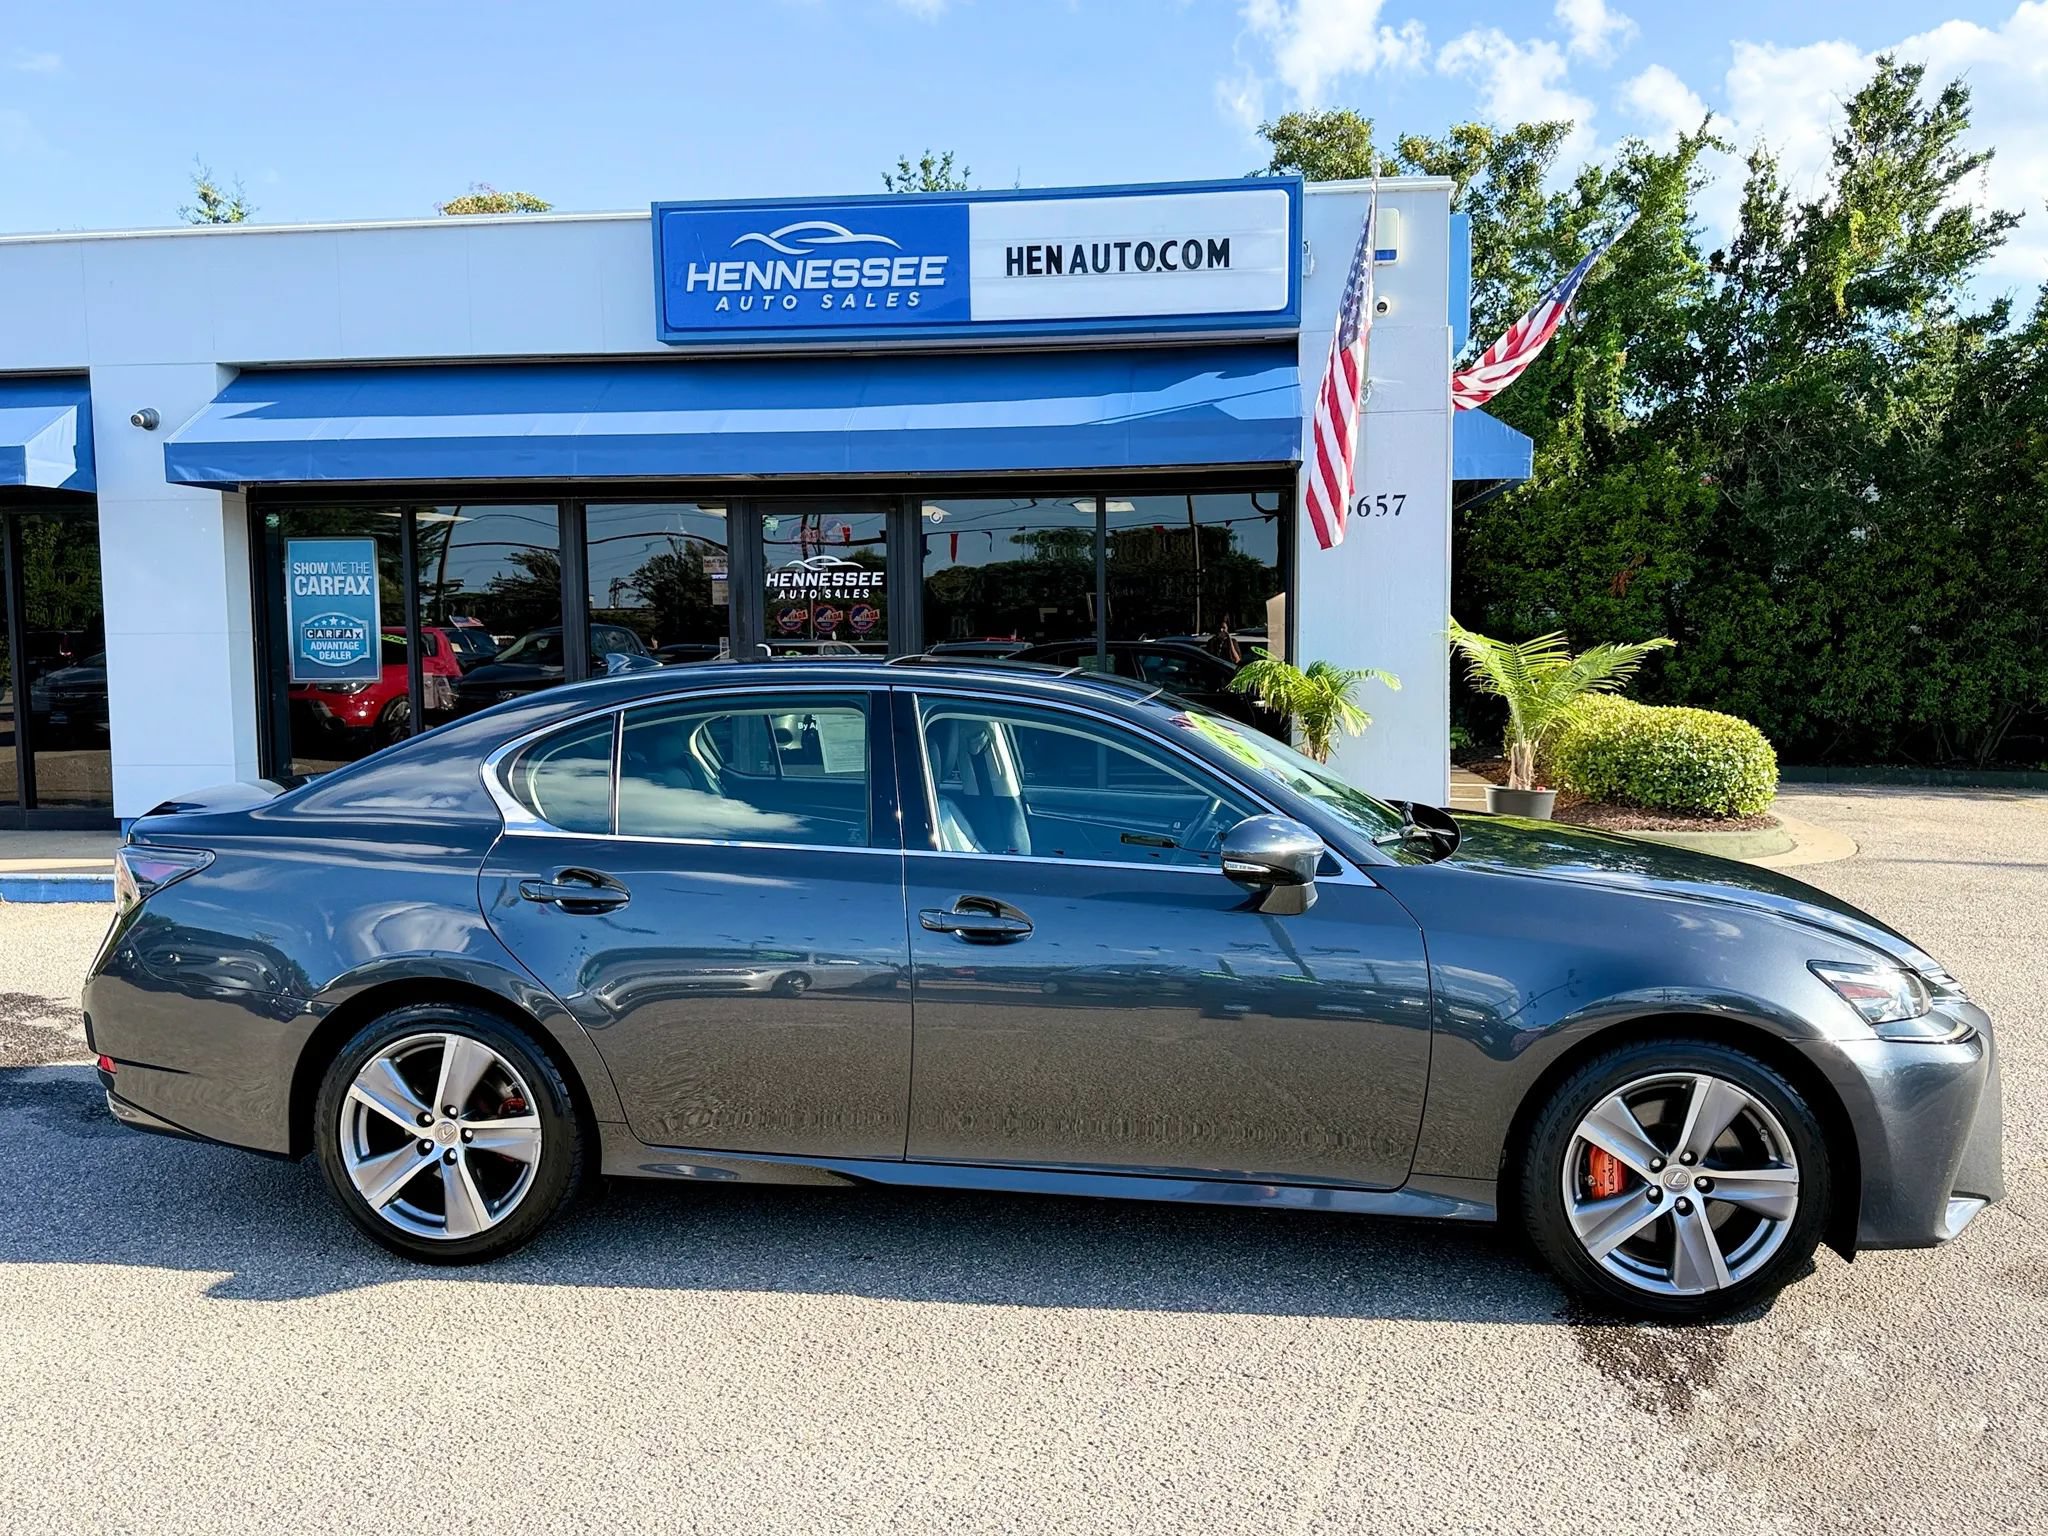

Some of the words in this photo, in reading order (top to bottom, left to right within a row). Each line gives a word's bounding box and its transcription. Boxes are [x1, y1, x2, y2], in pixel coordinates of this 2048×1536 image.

[686, 256, 949, 292] HENNESSEE
[715, 294, 798, 312] AUTO
[820, 291, 921, 309] SALES
[293, 562, 328, 575] SHOW
[331, 562, 350, 575] ME
[350, 562, 370, 575] THE
[294, 576, 371, 596] CARFAX
[766, 572, 884, 588] HENNESSEE
[778, 589, 818, 600] AUTO
[824, 588, 870, 599] SALES
[306, 628, 363, 639] CARFAX
[310, 641, 360, 650] ADVANTAGE
[319, 651, 352, 660] DEALER
[797, 722, 808, 731] By
